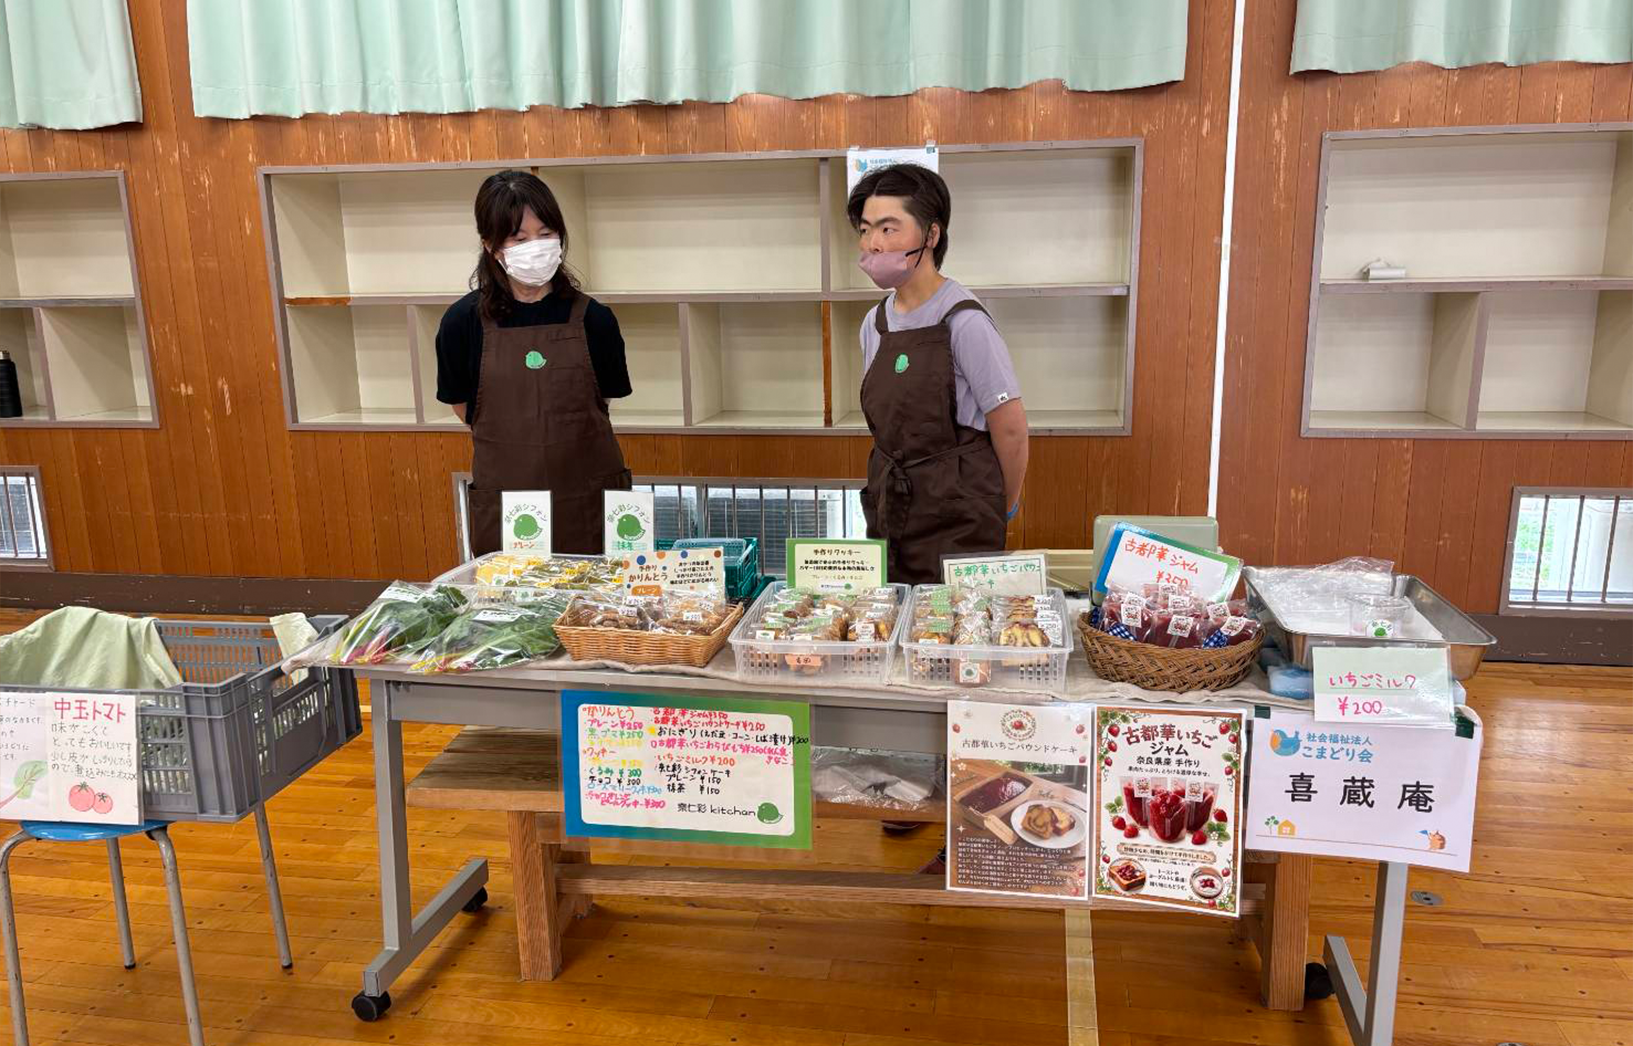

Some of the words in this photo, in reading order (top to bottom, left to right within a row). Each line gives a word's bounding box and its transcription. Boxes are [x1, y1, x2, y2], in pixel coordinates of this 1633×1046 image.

[1124, 538, 1200, 575] 古都華ジャム
[628, 572, 669, 583] かりんとう
[1328, 671, 1417, 690] いちごミルク
[54, 697, 126, 724] 中玉トマト
[1337, 696, 1383, 717] ¥200
[1122, 723, 1219, 750] 古都華いちご
[1306, 732, 1374, 747] 社会福祉法人
[961, 738, 1079, 755] 古都華いちごパウンドケーキ
[1149, 742, 1190, 757] ジャム
[1302, 745, 1375, 764] こまどり会
[1136, 755, 1173, 768] 奈良県産
[1175, 757, 1200, 769] 手作り
[710, 804, 756, 817] kitchan
